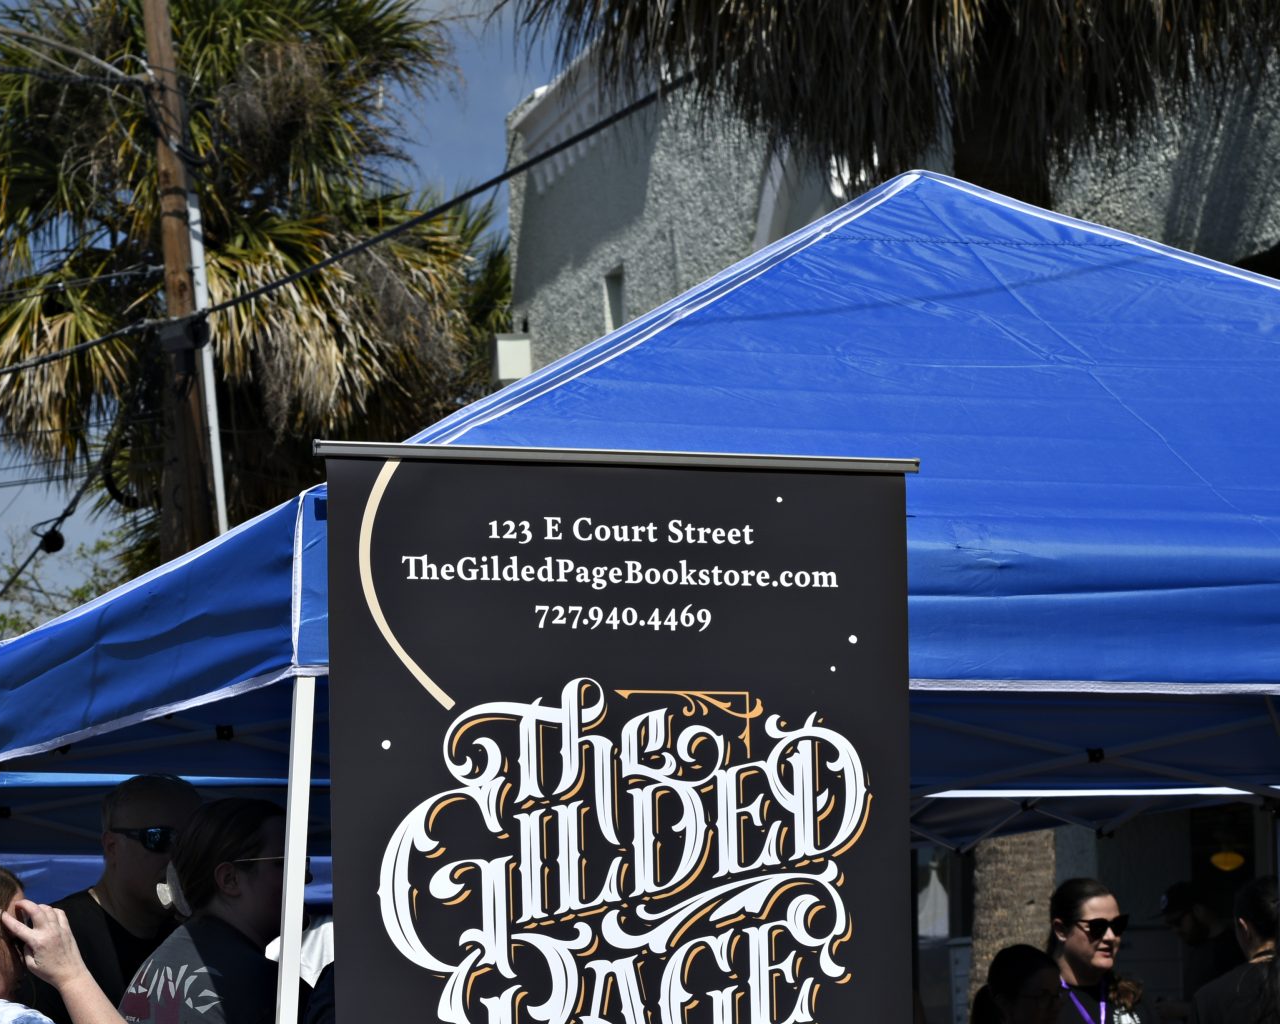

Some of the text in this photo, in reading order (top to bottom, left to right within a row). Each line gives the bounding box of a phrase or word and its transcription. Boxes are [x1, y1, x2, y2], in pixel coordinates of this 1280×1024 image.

[488, 516, 755, 546] 123 E Court Street
[401, 554, 839, 590] TheGildedPageBookstore.com
[534, 604, 713, 632] 727.940.4469
